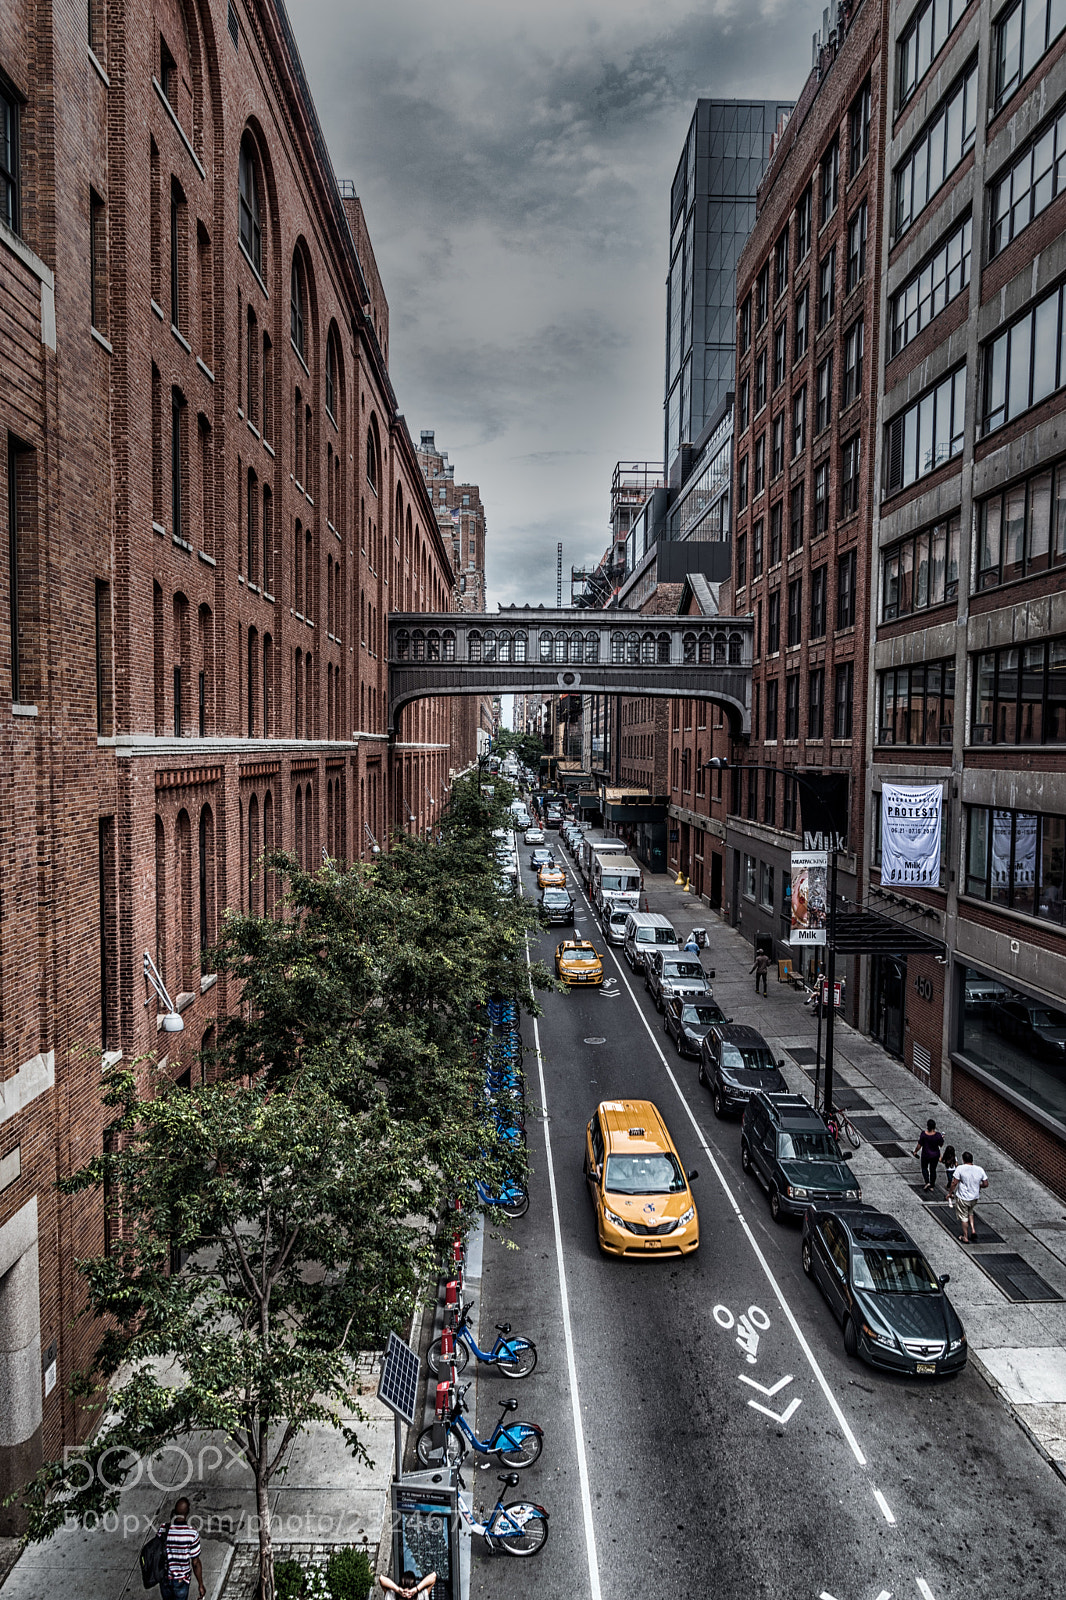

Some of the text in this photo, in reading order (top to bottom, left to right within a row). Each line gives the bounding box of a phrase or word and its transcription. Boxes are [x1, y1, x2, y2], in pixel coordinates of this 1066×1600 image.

[888, 806, 938, 817] PROTEST!
[803, 831, 844, 850] Milk
[904, 861, 921, 869] Milk
[798, 930, 817, 939] Milk
